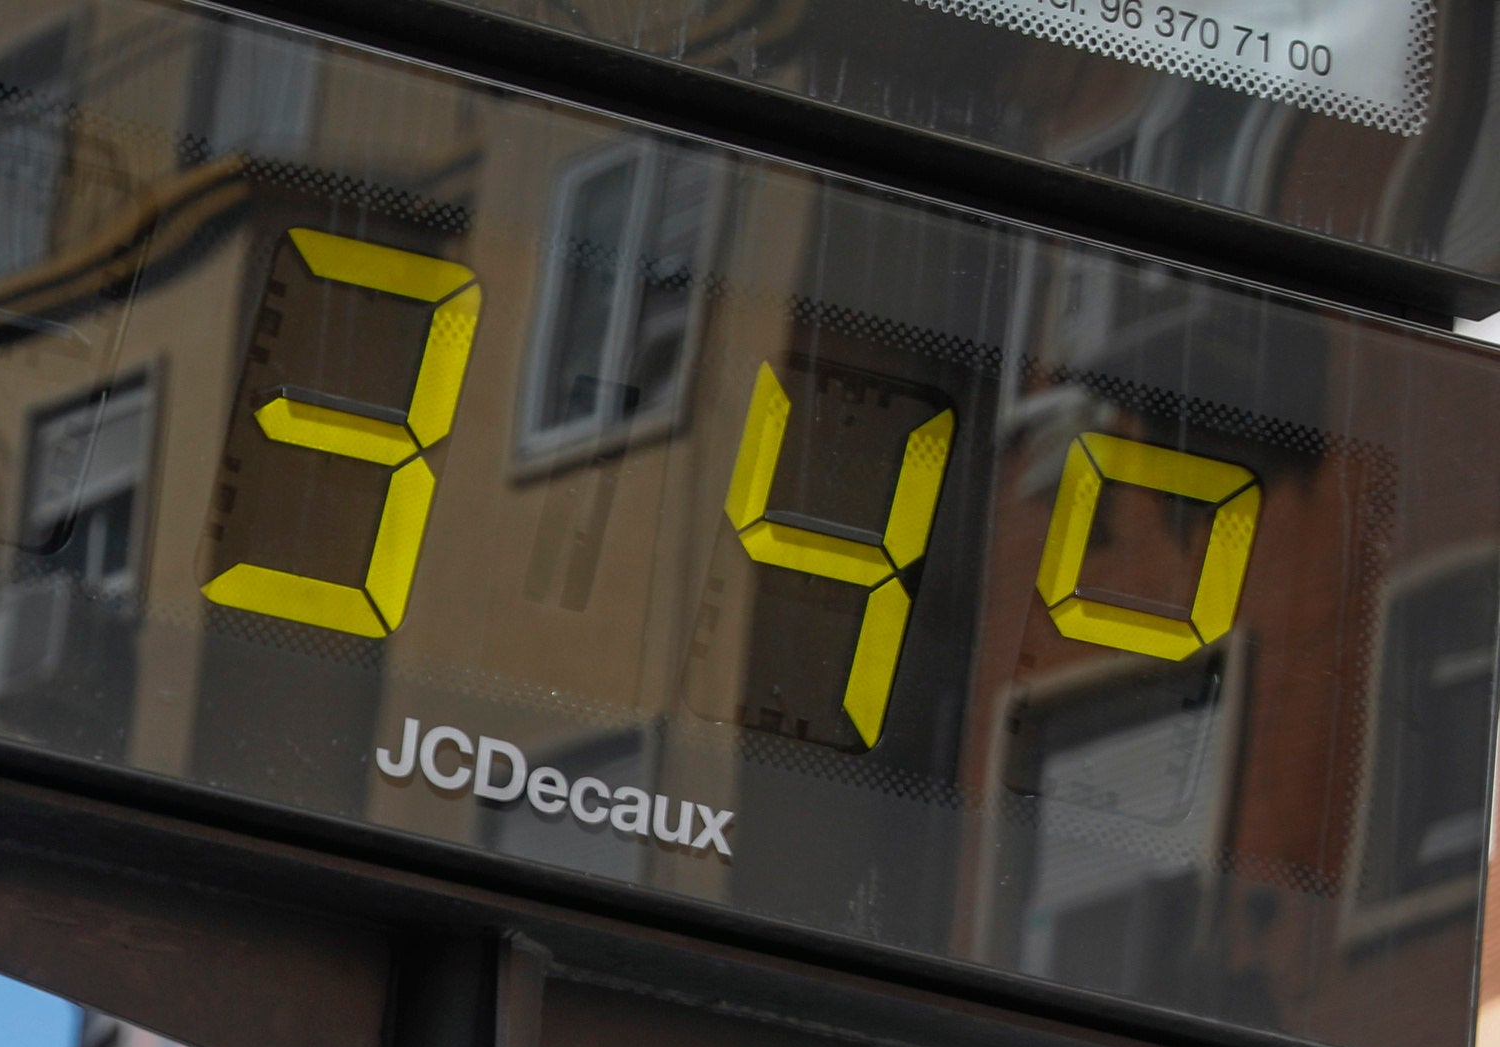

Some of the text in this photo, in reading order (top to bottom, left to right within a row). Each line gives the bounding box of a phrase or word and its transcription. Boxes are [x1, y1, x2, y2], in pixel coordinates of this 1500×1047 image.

[1100, 0, 1142, 29] 96
[1154, 6, 1219, 50] 370
[1233, 25, 1270, 63] 71
[1288, 40, 1331, 76] 00
[376, 717, 735, 857] JCDecaux
